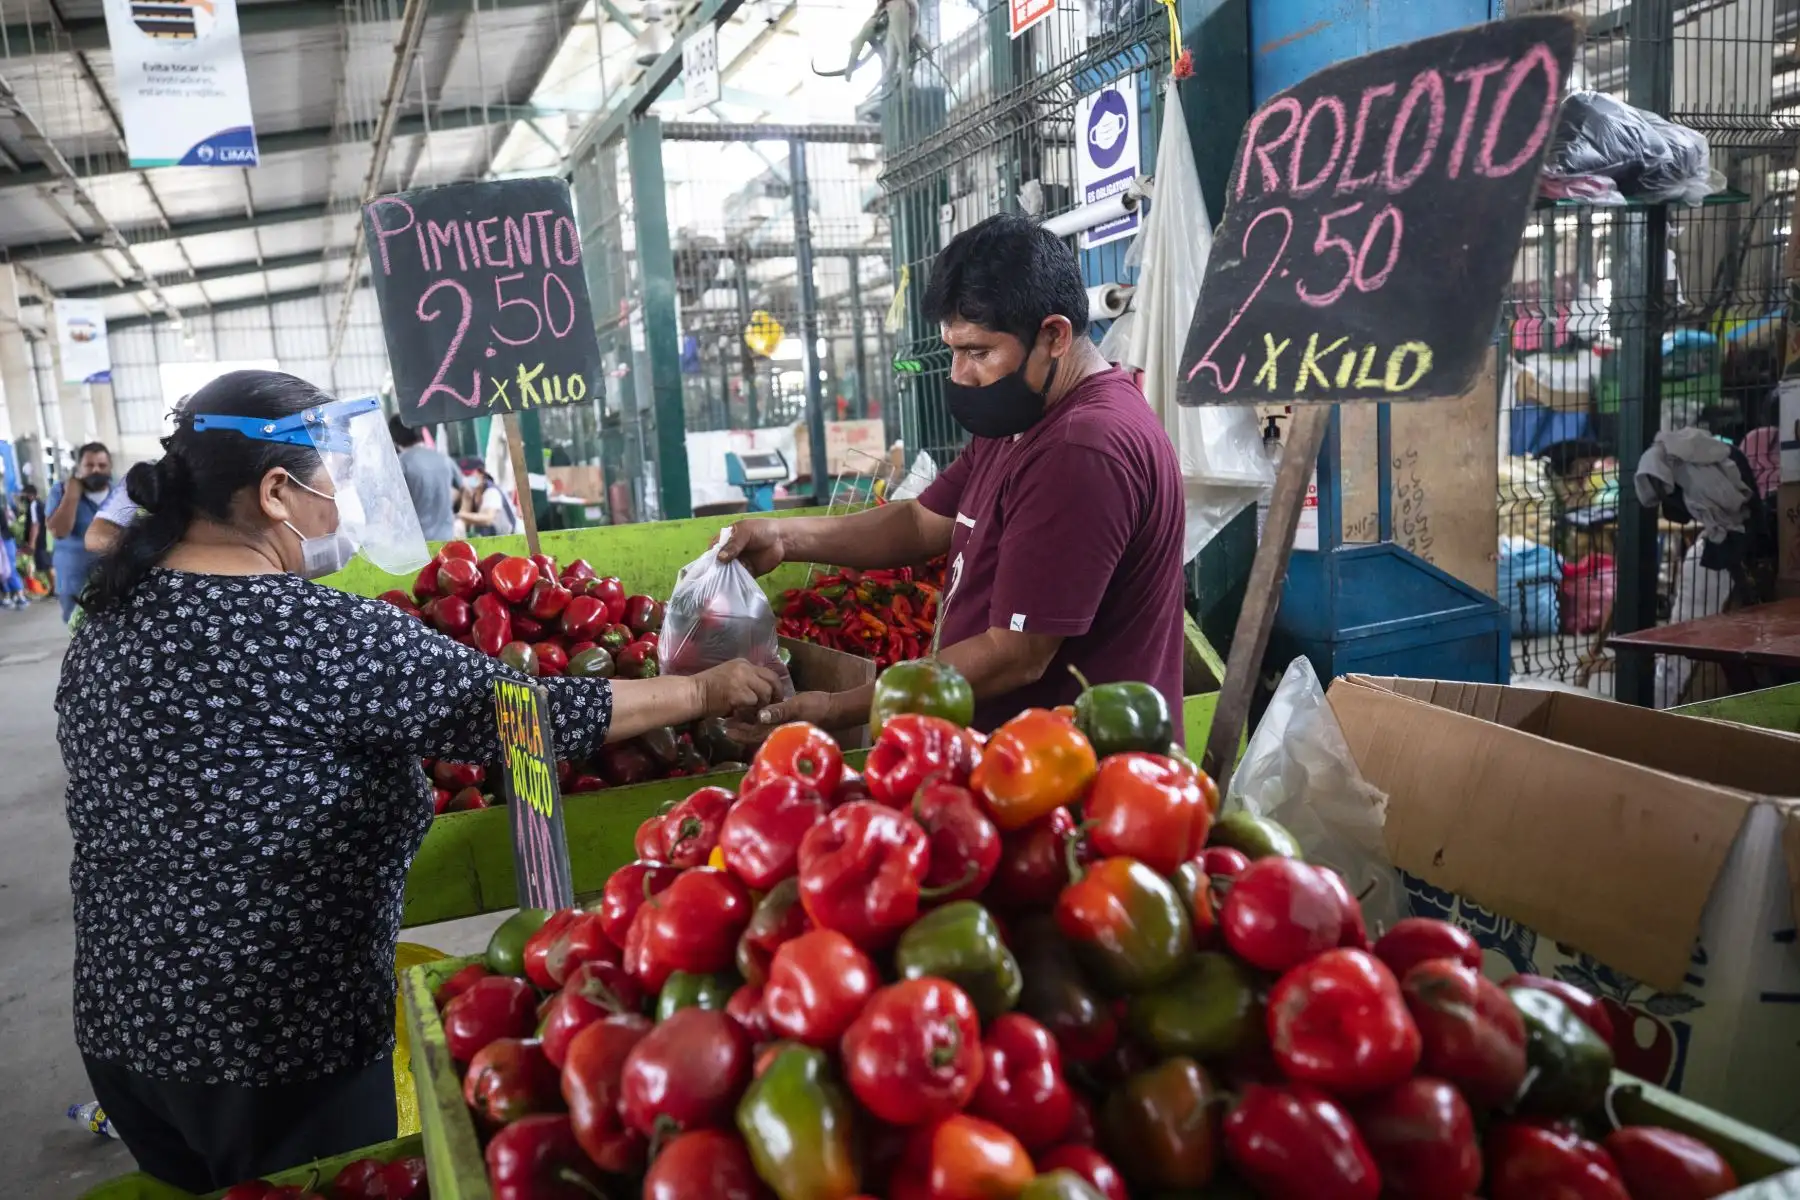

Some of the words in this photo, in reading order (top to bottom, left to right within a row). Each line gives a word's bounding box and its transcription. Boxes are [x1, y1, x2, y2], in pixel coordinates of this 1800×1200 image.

[220, 149, 256, 162] LIMA
[1237, 42, 1560, 201] ROCOTO
[367, 197, 581, 275] PIMIENTO
[1087, 190, 1096, 204] ES
[416, 272, 576, 408] 2.50
[1185, 202, 1404, 394] 2.50
